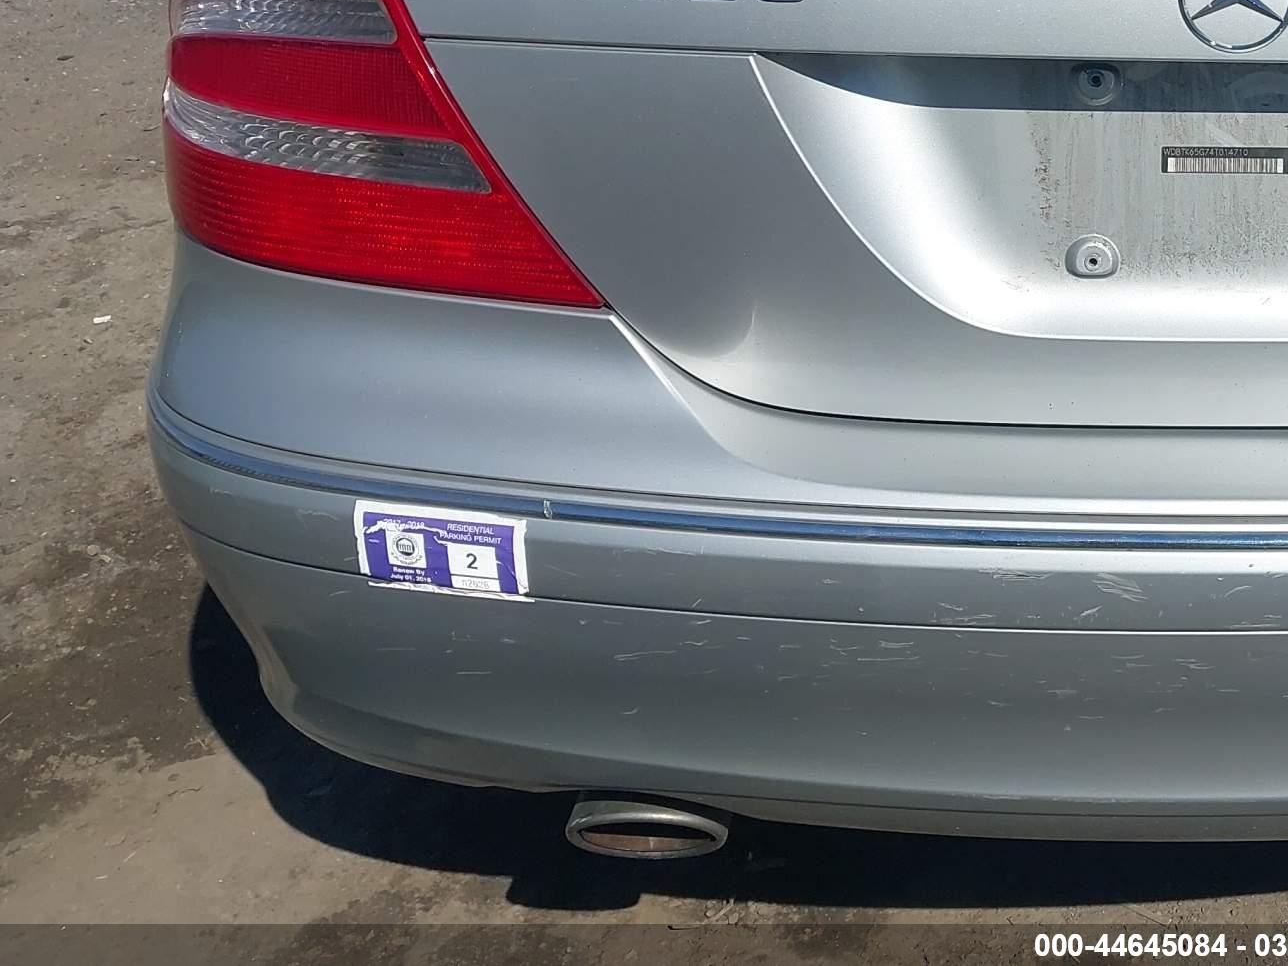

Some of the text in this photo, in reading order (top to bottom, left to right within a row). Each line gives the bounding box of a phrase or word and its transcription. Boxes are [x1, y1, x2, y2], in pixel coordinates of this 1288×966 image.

[439, 529, 502, 544] PARKING PERMIT
[447, 523, 495, 535] RESIDENTIAL
[466, 552, 479, 570] 2
